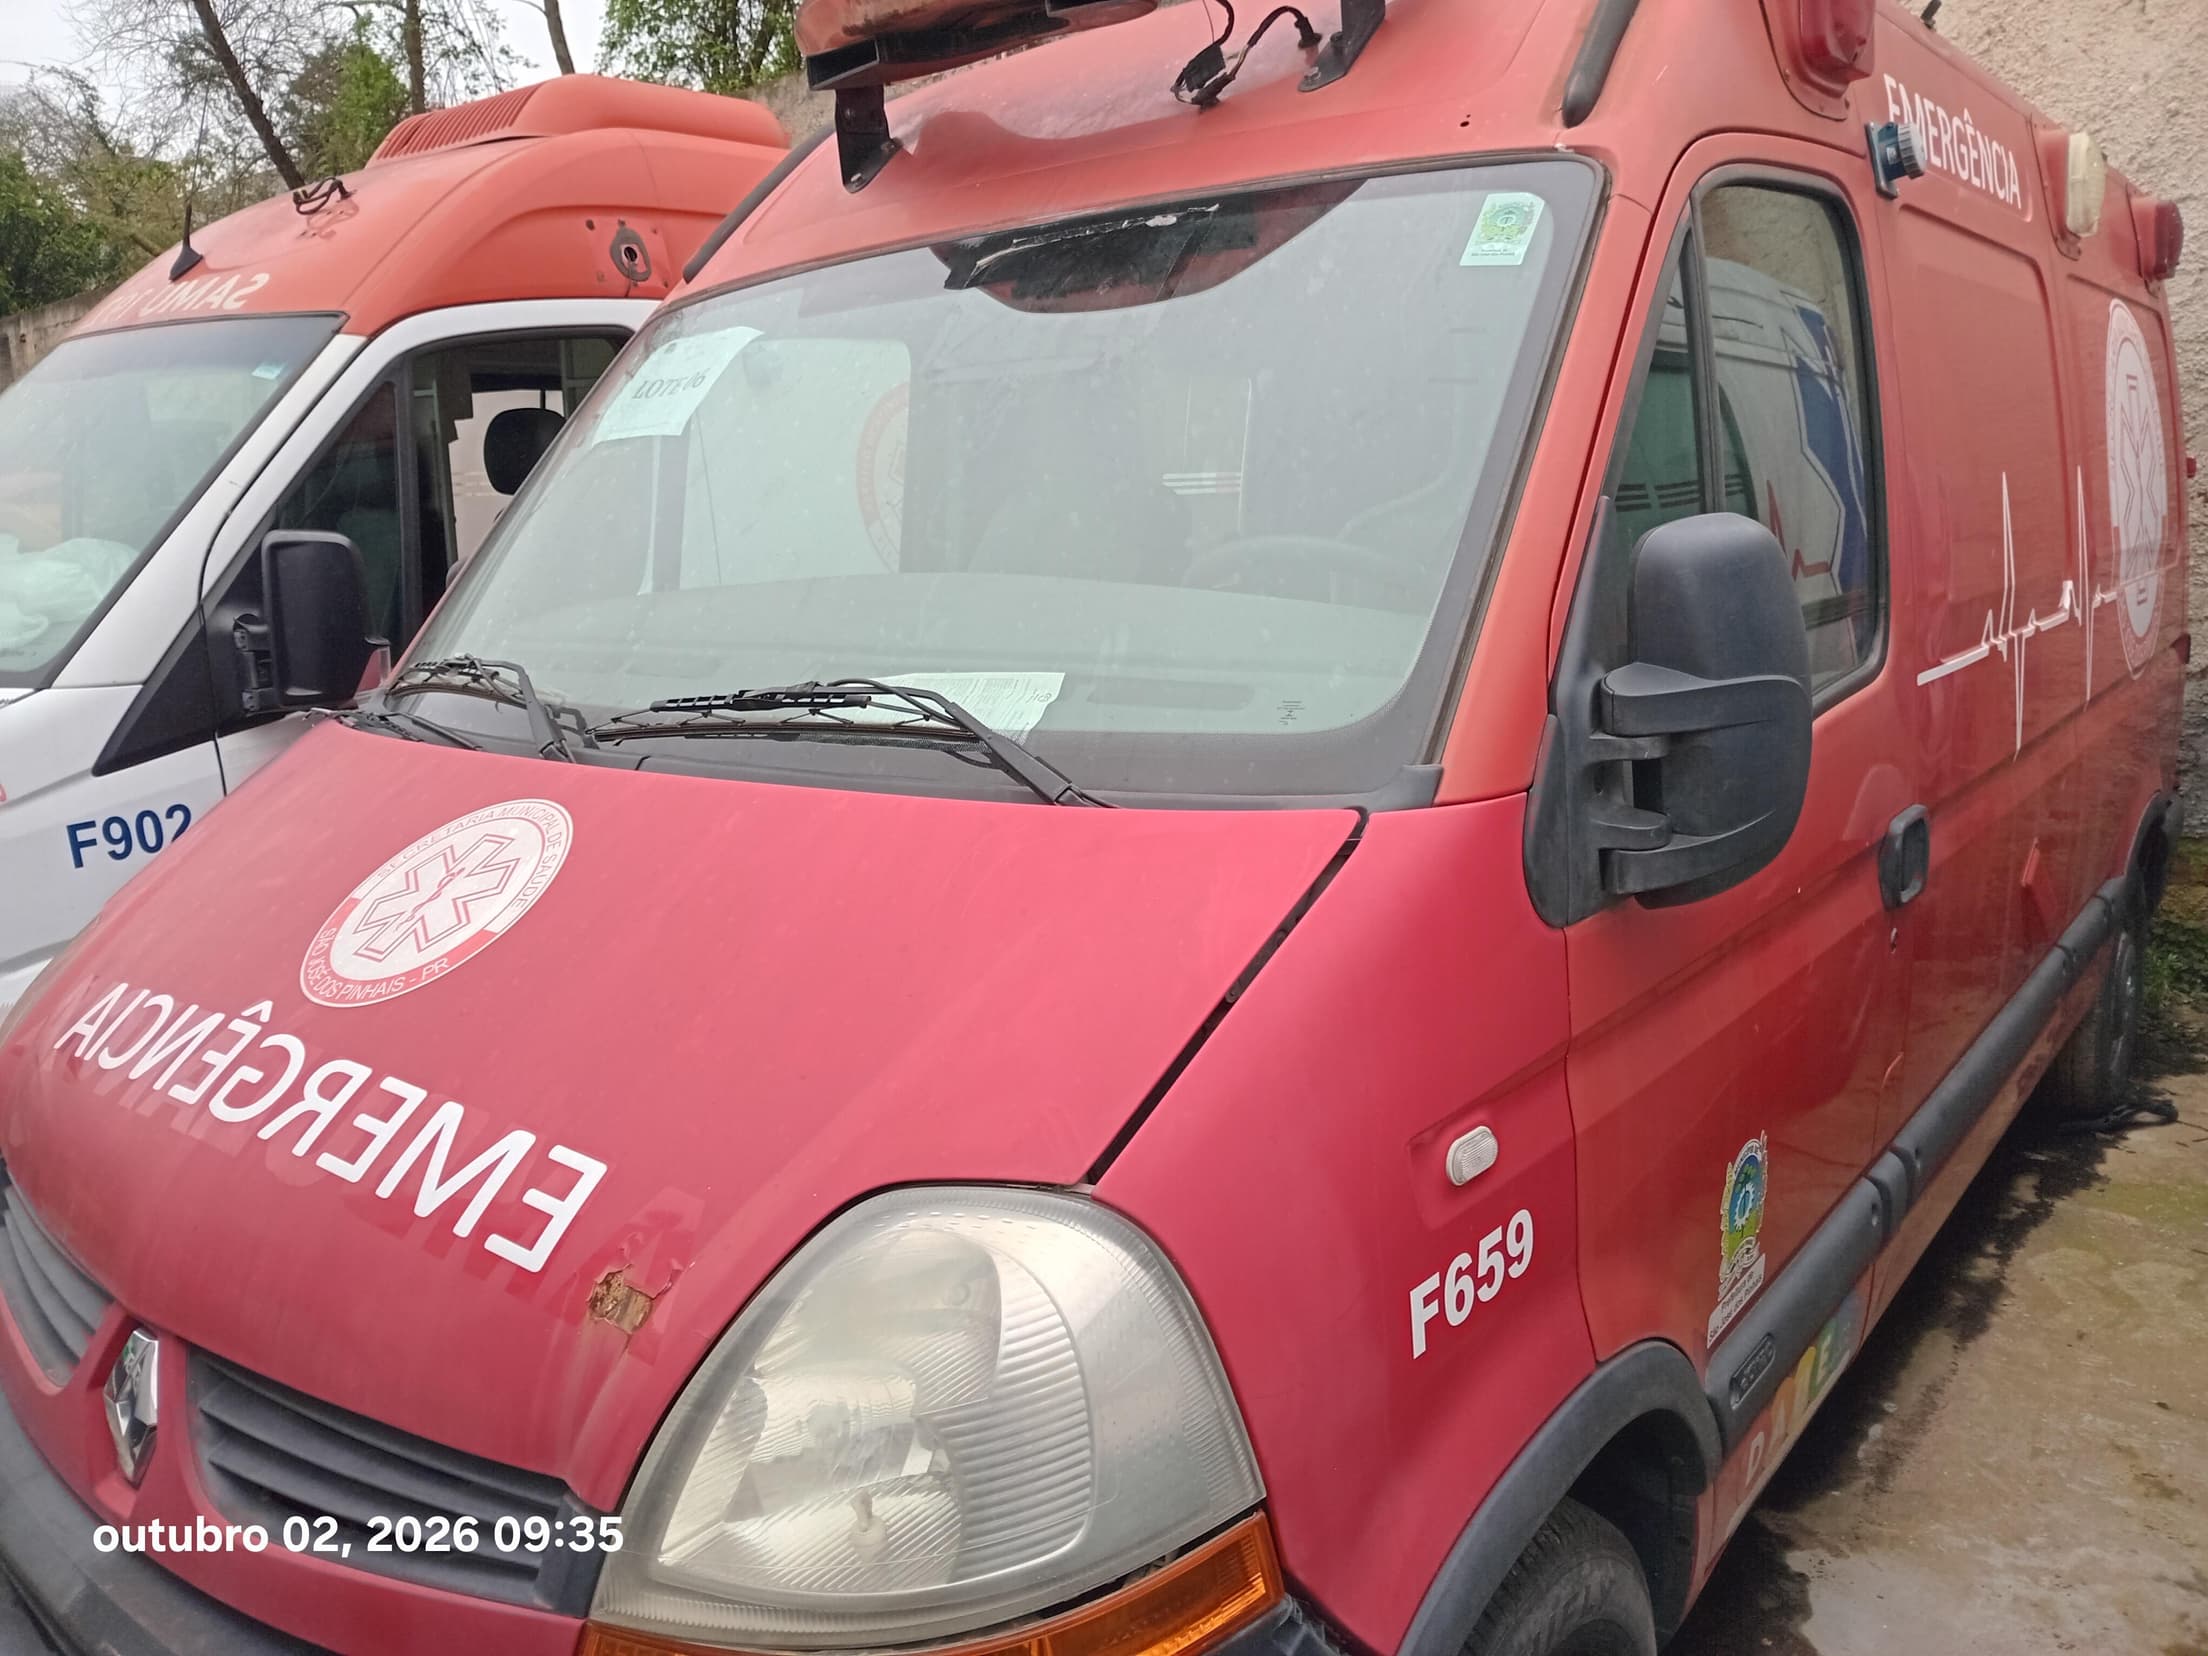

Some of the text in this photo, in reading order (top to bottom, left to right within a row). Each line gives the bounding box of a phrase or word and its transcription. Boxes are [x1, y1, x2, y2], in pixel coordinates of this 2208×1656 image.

[632, 377, 688, 399] LOTE
[66, 803, 192, 869] F902
[496, 806, 560, 834] MUNICIPAL
[546, 831, 562, 852] DE
[335, 976, 406, 1000] PINHAIS
[422, 957, 449, 980] PR
[1410, 1209, 1533, 1360] F659
